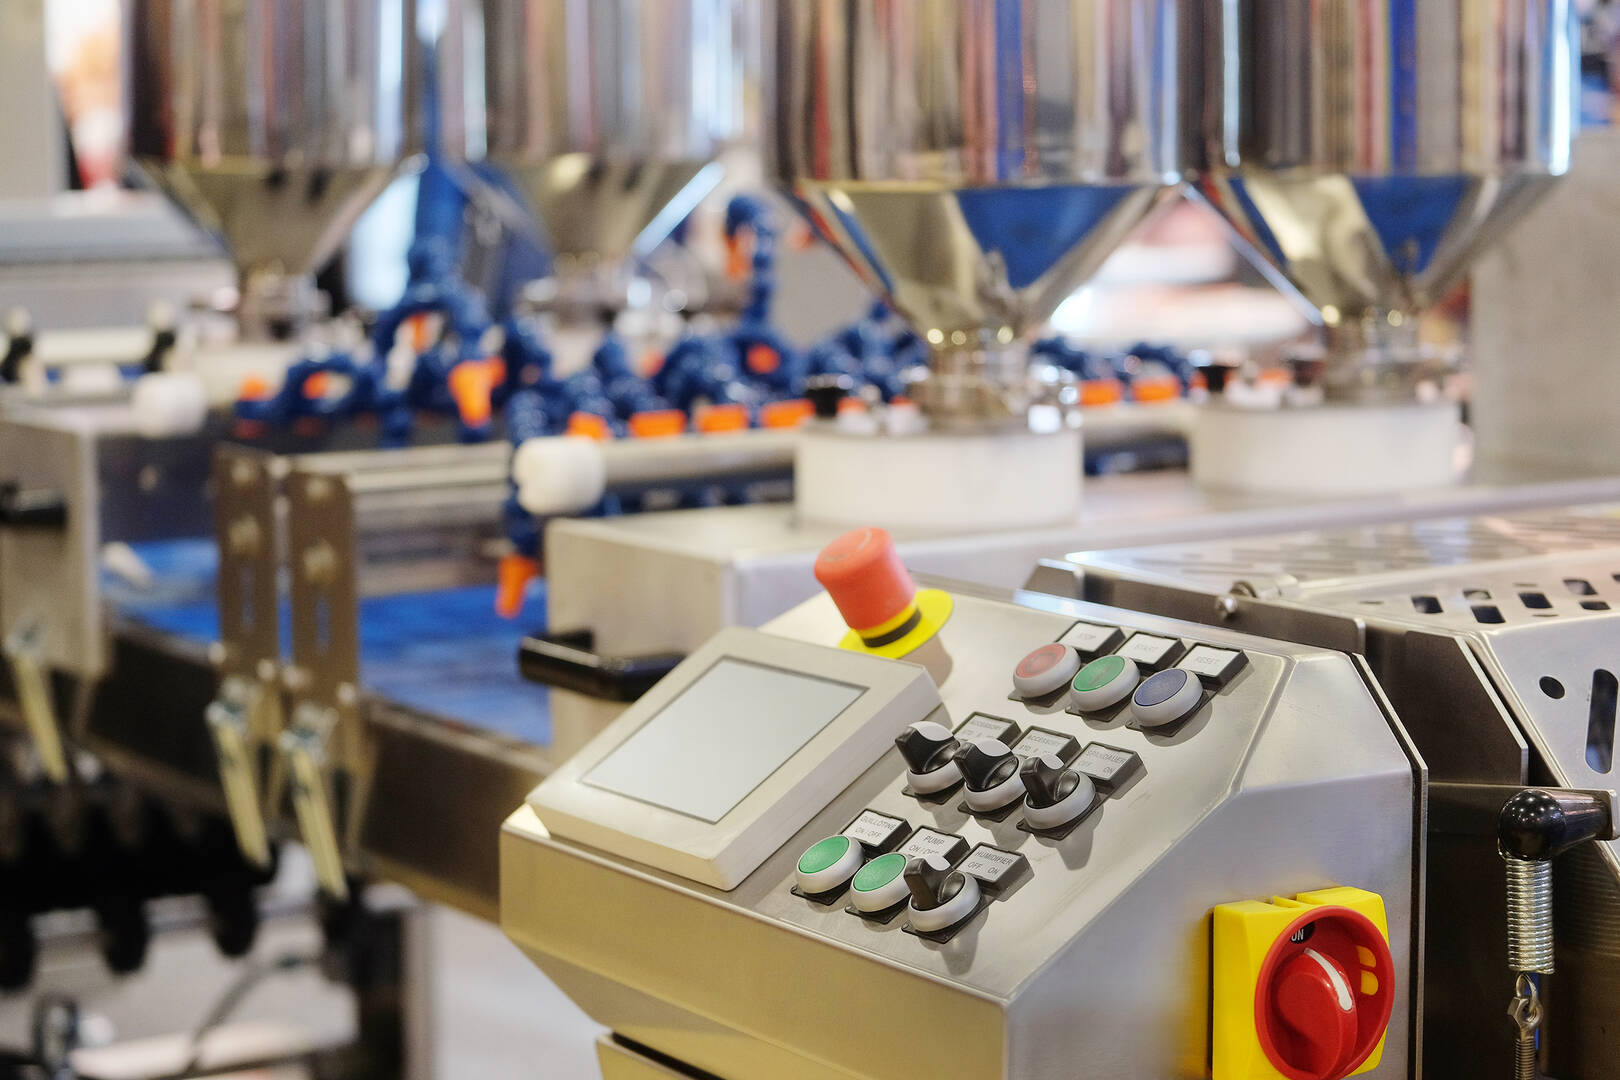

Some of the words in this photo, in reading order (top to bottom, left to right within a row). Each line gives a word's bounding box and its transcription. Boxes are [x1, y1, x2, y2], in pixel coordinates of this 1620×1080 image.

[924, 835, 945, 847] PUMP
[975, 851, 1013, 866] HUMIDIFIER
[967, 861, 982, 870] OFF
[988, 867, 1000, 875] ON
